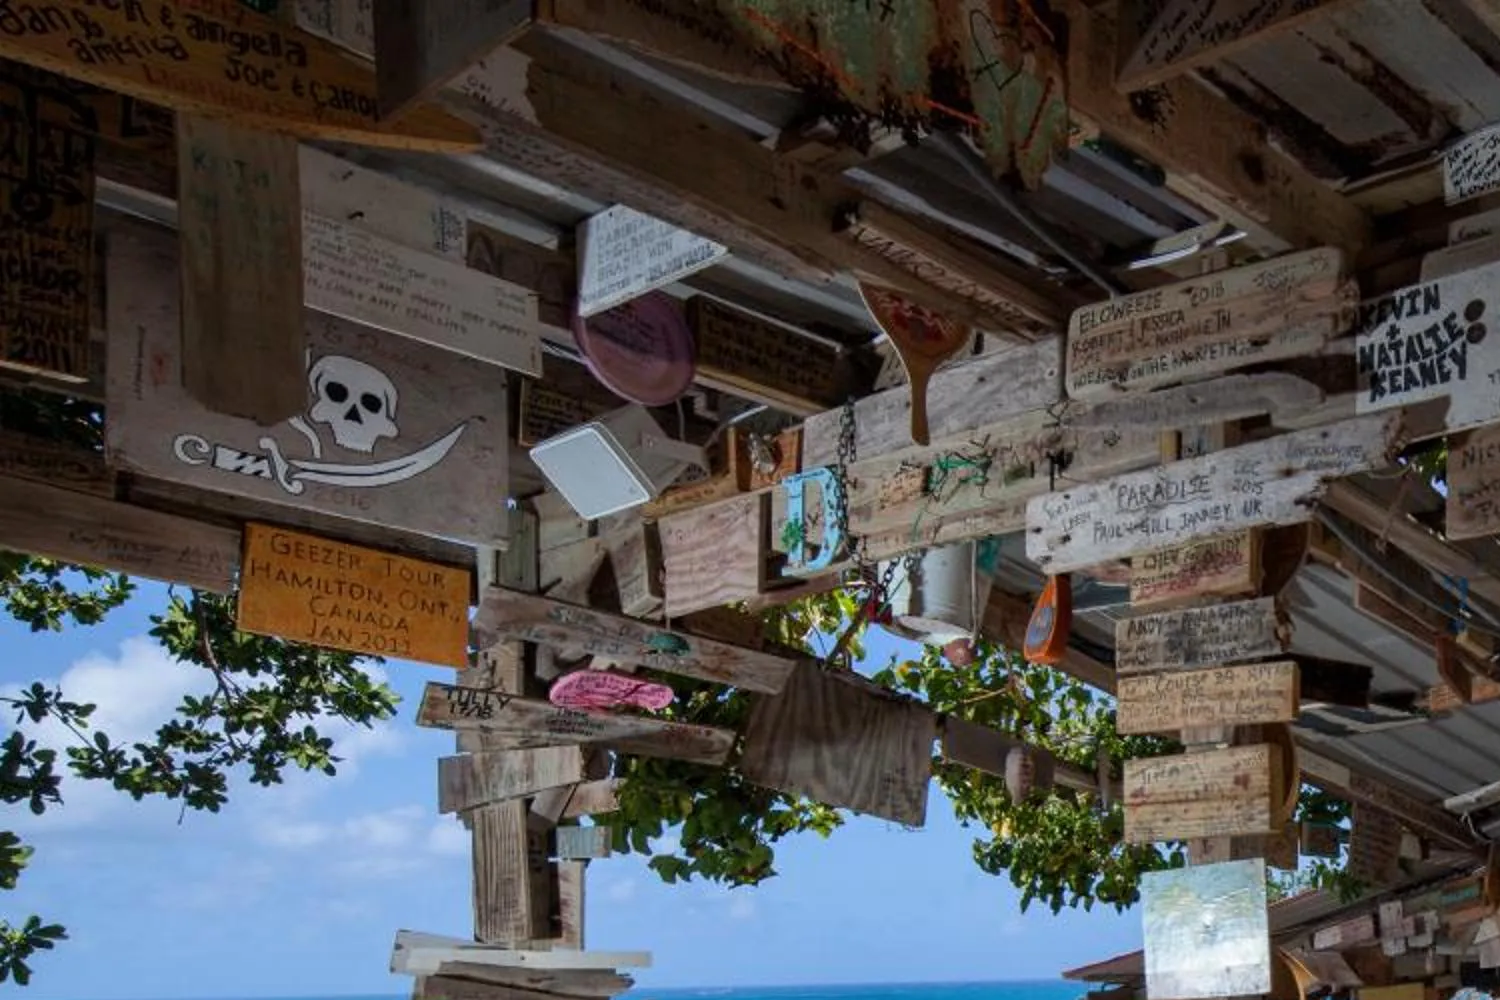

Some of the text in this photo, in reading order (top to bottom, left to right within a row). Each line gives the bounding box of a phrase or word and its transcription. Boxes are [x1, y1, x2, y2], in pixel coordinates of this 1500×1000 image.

[1357, 283, 1441, 337] KEVIN
[1359, 311, 1465, 373] NATALIE
[1369, 340, 1467, 404] KEANEY
[269, 532, 447, 592] GEEZER TOUR
[304, 618, 352, 646] JAN
[307, 596, 411, 635] CANADA
